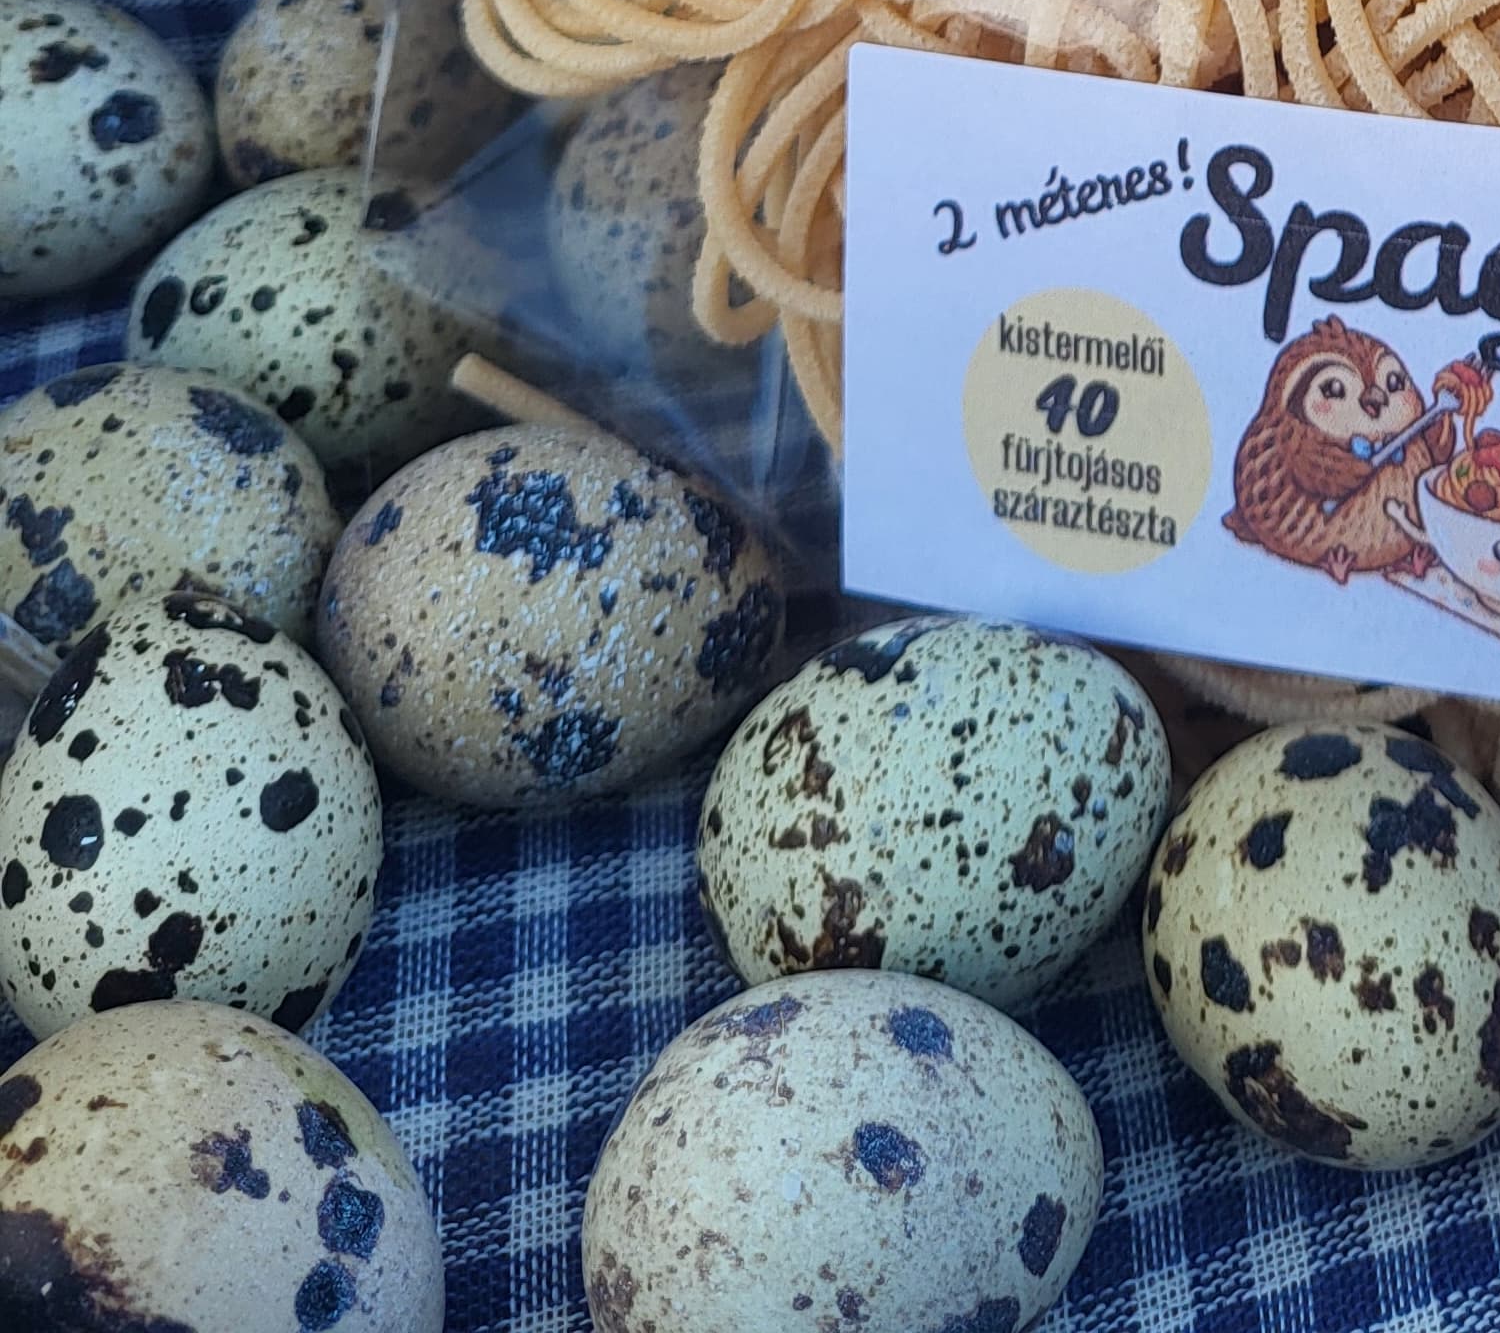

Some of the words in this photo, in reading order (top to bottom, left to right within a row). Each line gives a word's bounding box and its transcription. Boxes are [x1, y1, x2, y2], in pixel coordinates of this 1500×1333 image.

[932, 198, 978, 256] 2
[999, 312, 1166, 377] kistermelői
[1035, 373, 1121, 437] 40
[1001, 432, 1163, 496] fürjtojásos
[993, 485, 1177, 547] száraztészta
